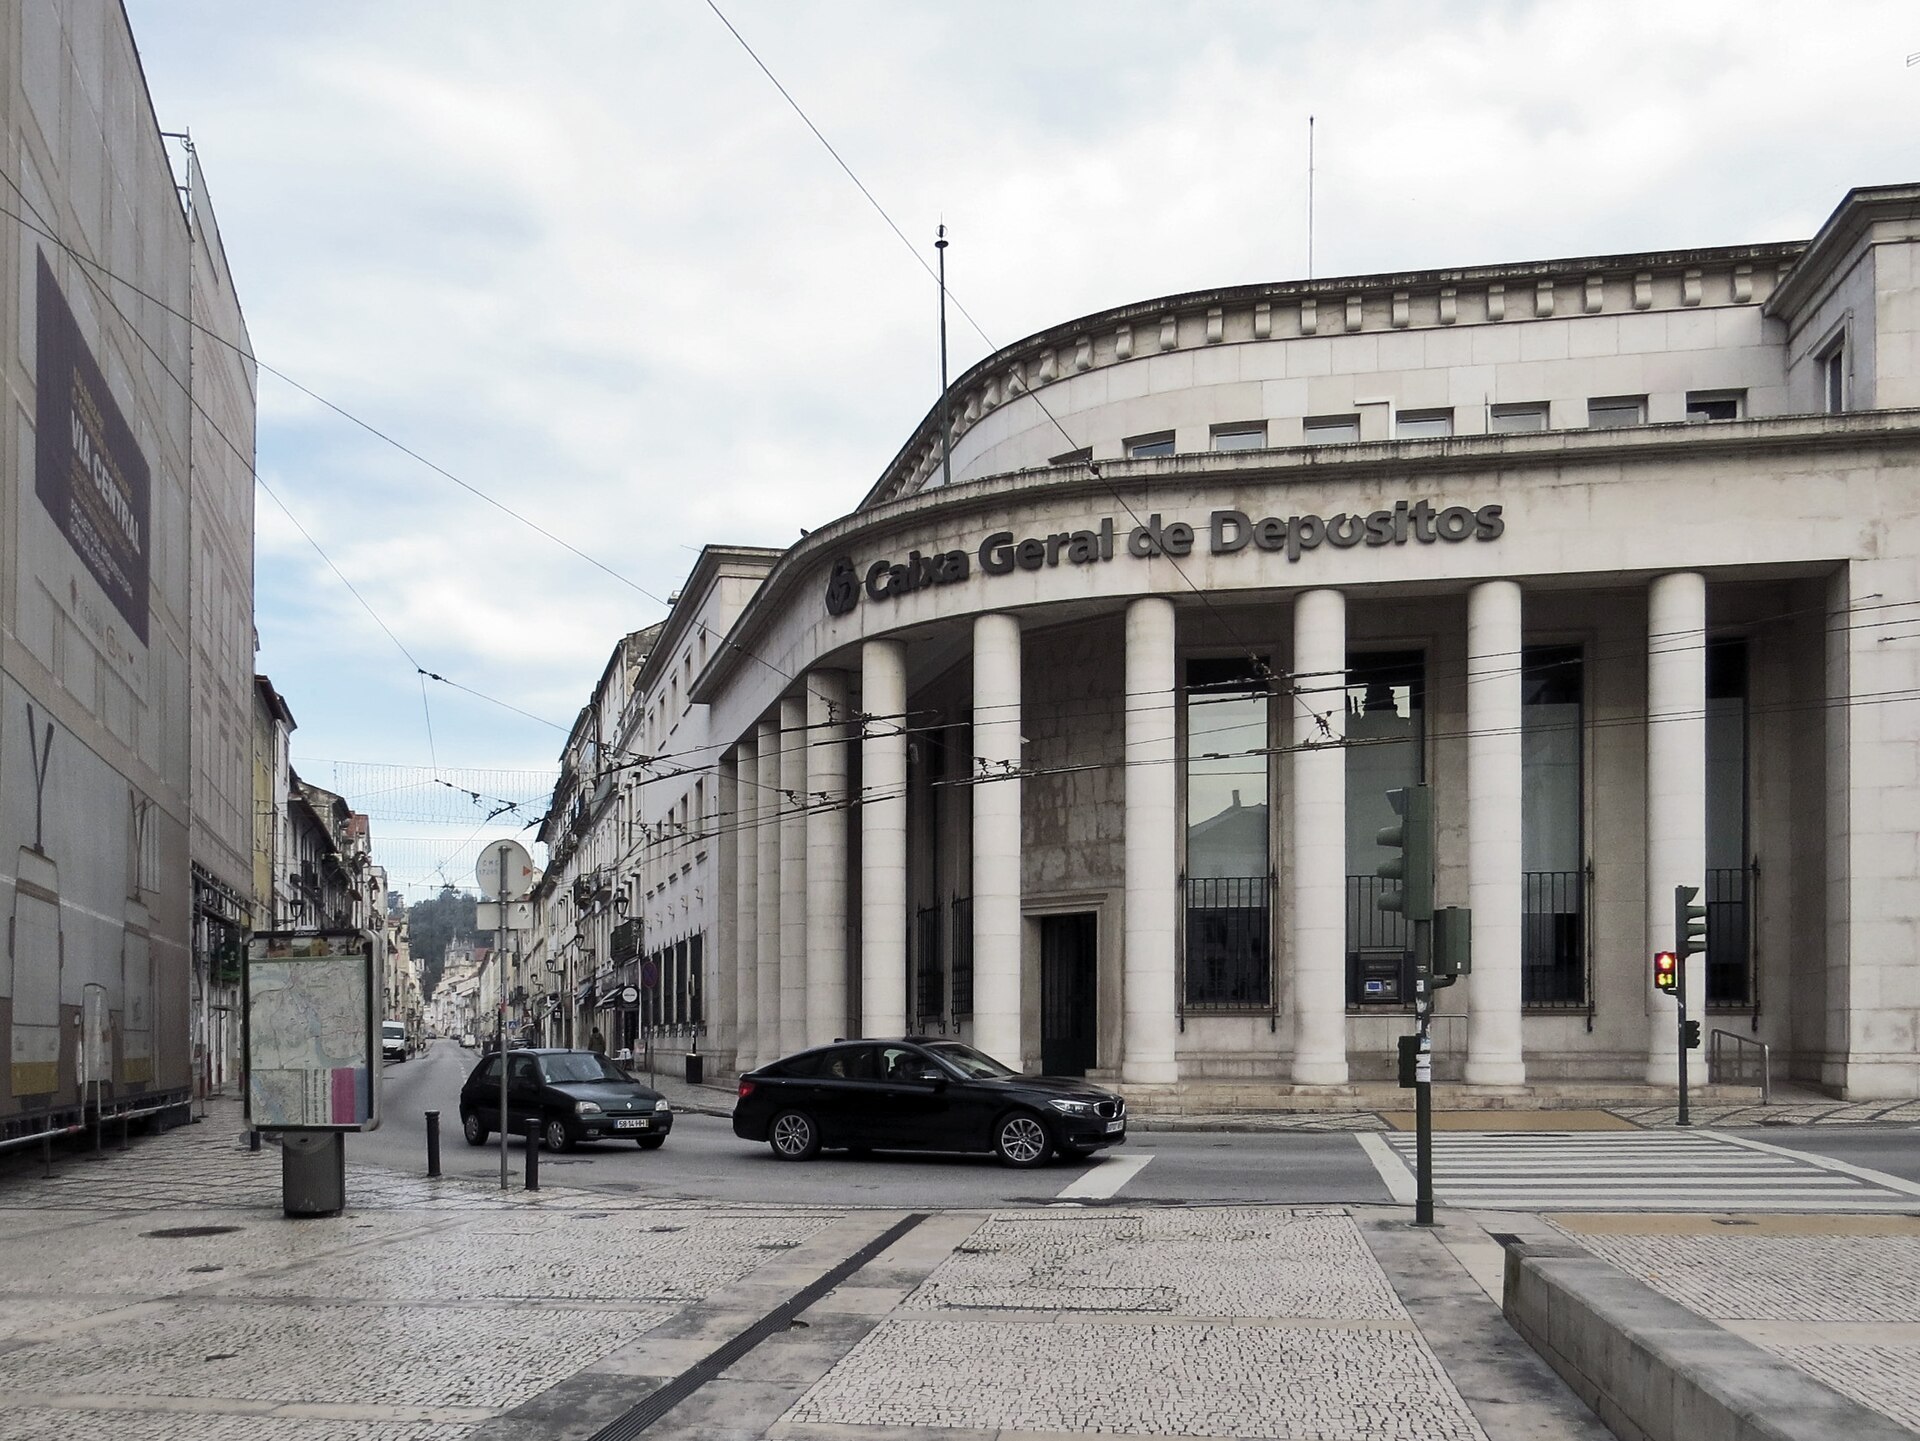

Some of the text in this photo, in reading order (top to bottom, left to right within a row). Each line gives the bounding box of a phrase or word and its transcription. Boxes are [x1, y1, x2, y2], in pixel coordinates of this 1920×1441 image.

[71, 409, 91, 474] VIA
[93, 453, 141, 556] CENTRAL
[865, 550, 970, 600] Caixa
[979, 517, 1113, 576] Geral
[1128, 513, 1194, 558] de
